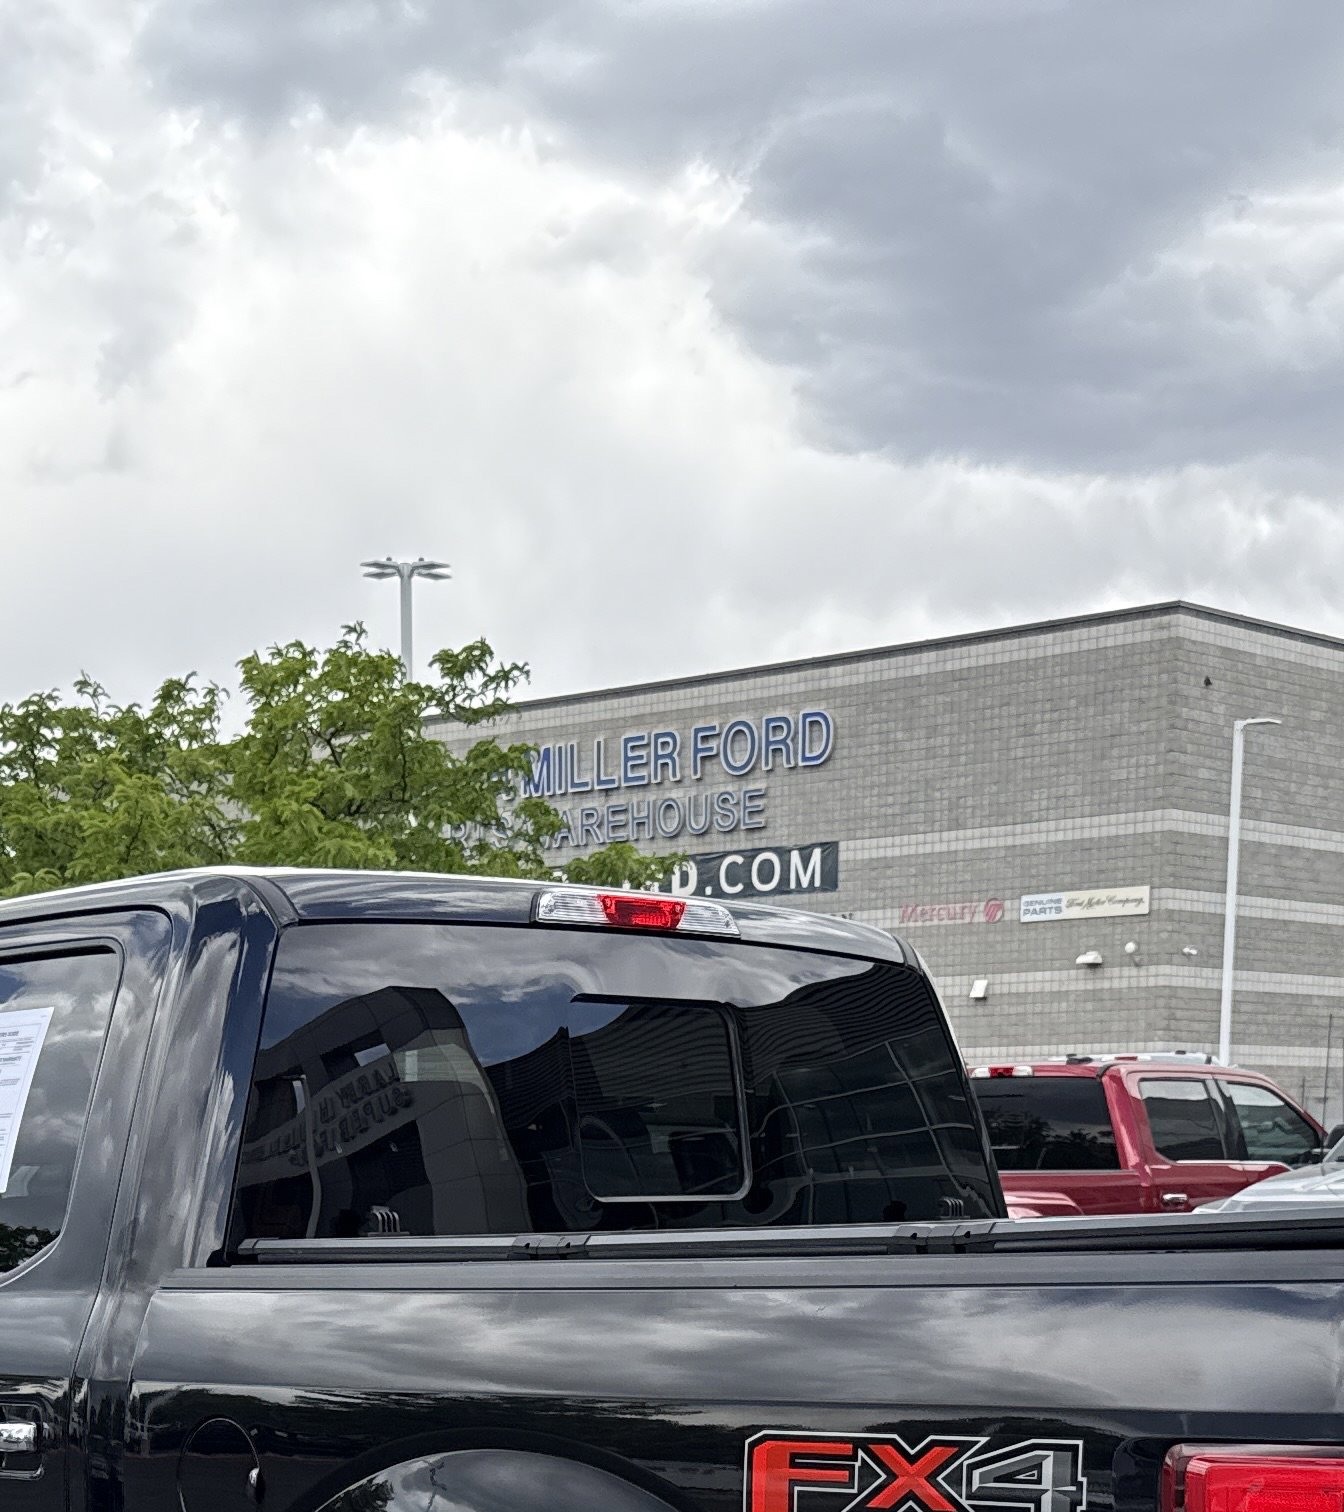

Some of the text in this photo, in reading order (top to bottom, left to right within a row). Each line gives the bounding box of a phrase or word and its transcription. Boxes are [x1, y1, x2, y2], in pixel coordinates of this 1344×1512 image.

[520, 710, 835, 799] MILLER FORD
[528, 786, 767, 849] AREHOUSE
[899, 902, 976, 924] Mercury
[1022, 906, 1063, 916] PARTS
[1023, 898, 1063, 907] GENUINE
